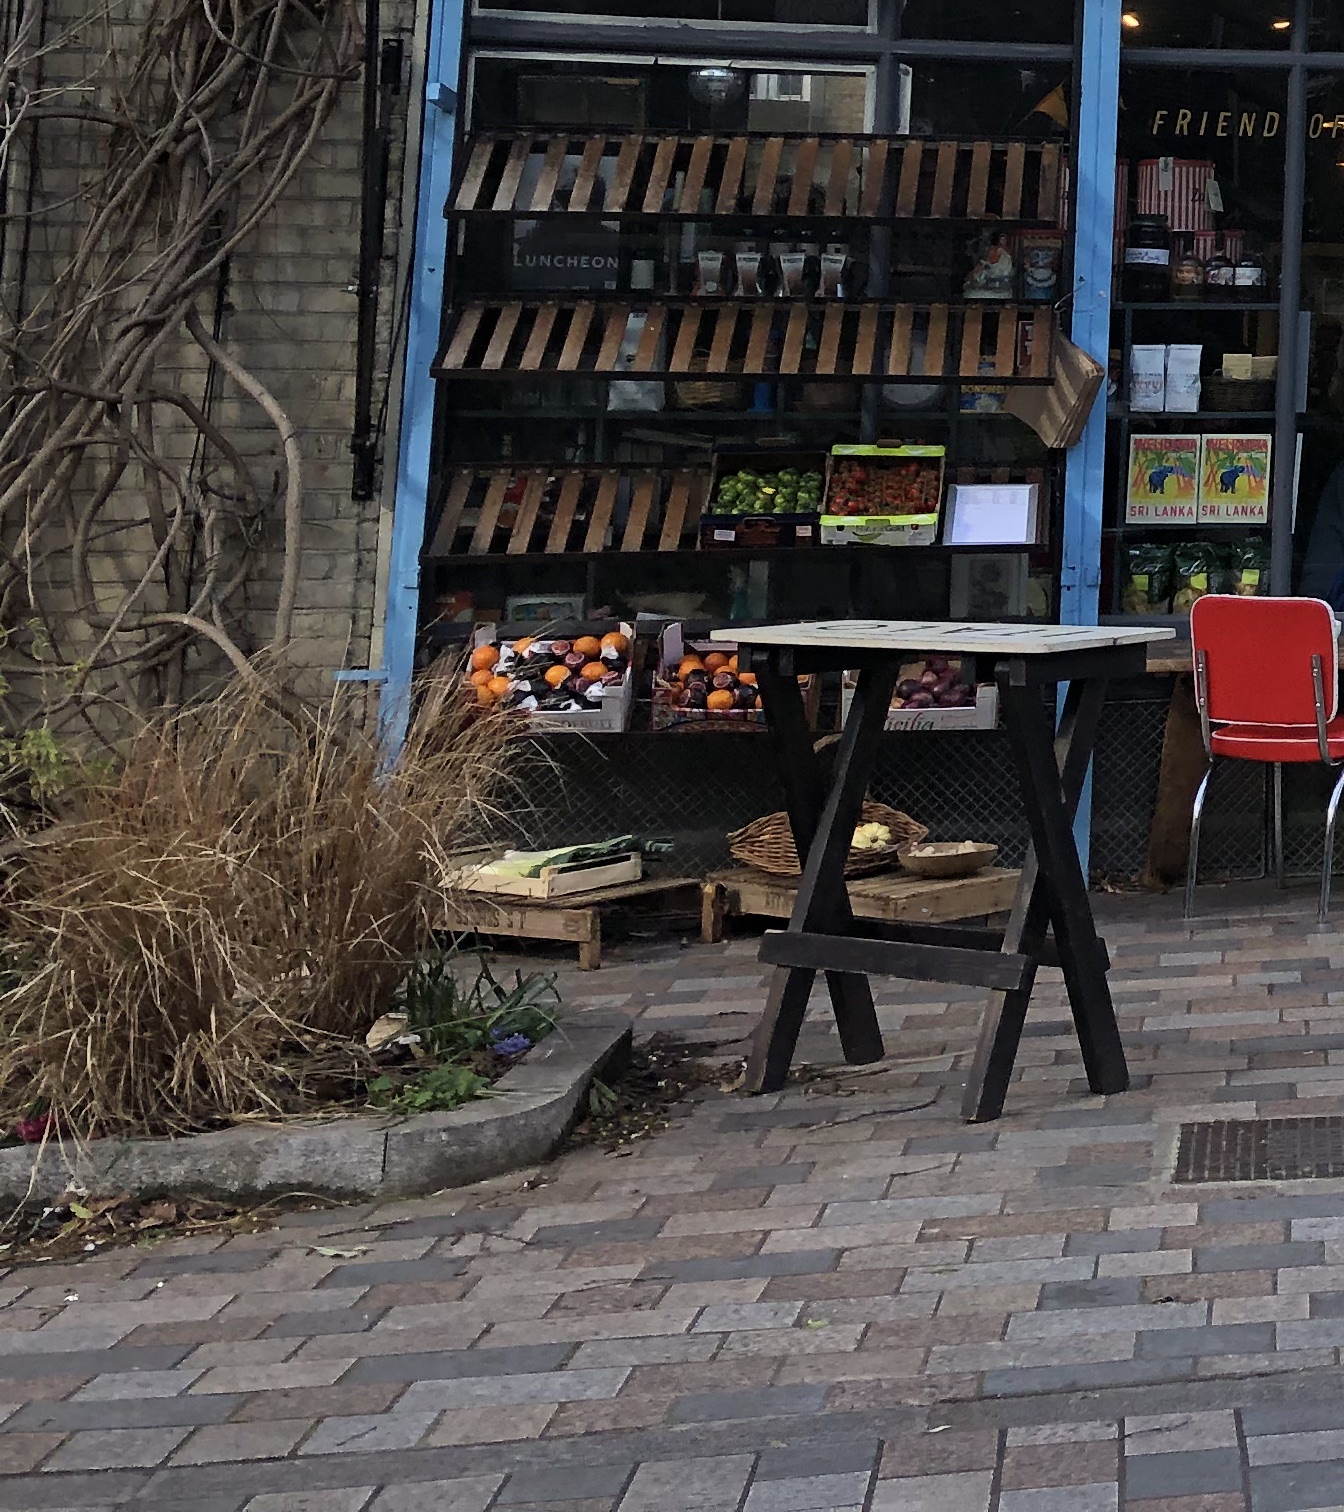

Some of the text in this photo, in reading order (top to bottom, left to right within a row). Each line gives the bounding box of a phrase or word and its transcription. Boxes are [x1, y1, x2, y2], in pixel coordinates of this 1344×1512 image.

[1152, 110, 1281, 138] FRIEND
[512, 251, 619, 269] LUNCHEON
[1130, 505, 1194, 517] SRI LANKA
[1201, 505, 1265, 517] SRI LANKA
